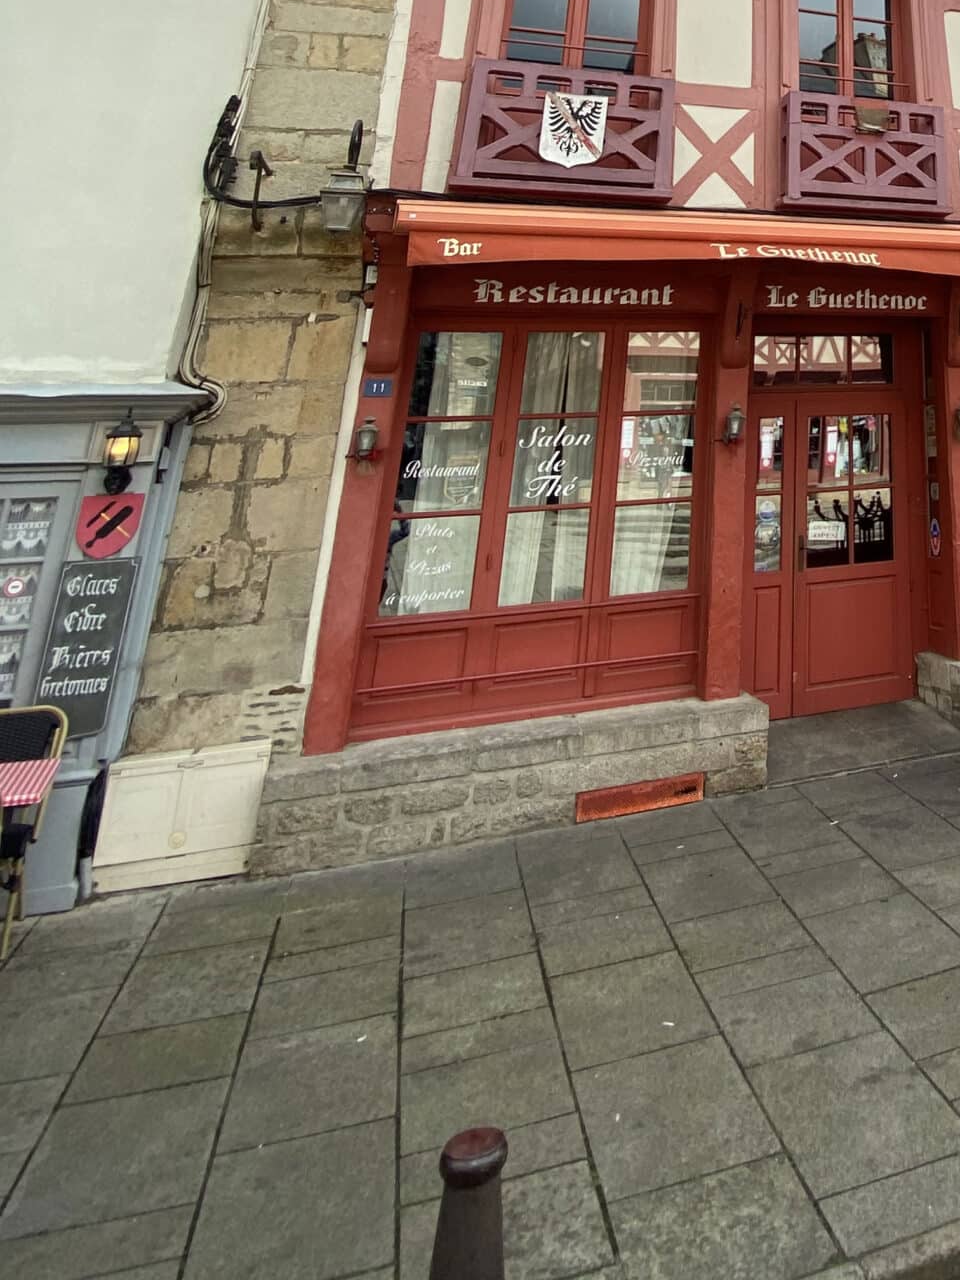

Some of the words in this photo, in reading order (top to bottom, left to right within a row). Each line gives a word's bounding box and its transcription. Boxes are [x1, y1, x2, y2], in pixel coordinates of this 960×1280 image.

[437, 238, 483, 257] Bar
[710, 243, 749, 260] Le
[756, 244, 881, 266] Guethenoc
[472, 278, 675, 306] Restaurant
[765, 285, 800, 308] Le
[807, 286, 928, 311] Guethenoc
[372, 383, 385, 393] 11
[518, 425, 593, 449] Salon
[403, 459, 481, 479] Restaurant
[537, 450, 567, 473] de
[628, 451, 687, 468] Pizzeria
[525, 474, 579, 499] Thé
[415, 522, 455, 538] Plats
[67, 575, 120, 596] Glaces
[399, 588, 465, 609] emporter
[64, 604, 107, 633] Cidre
[50, 645, 113, 672] Bières
